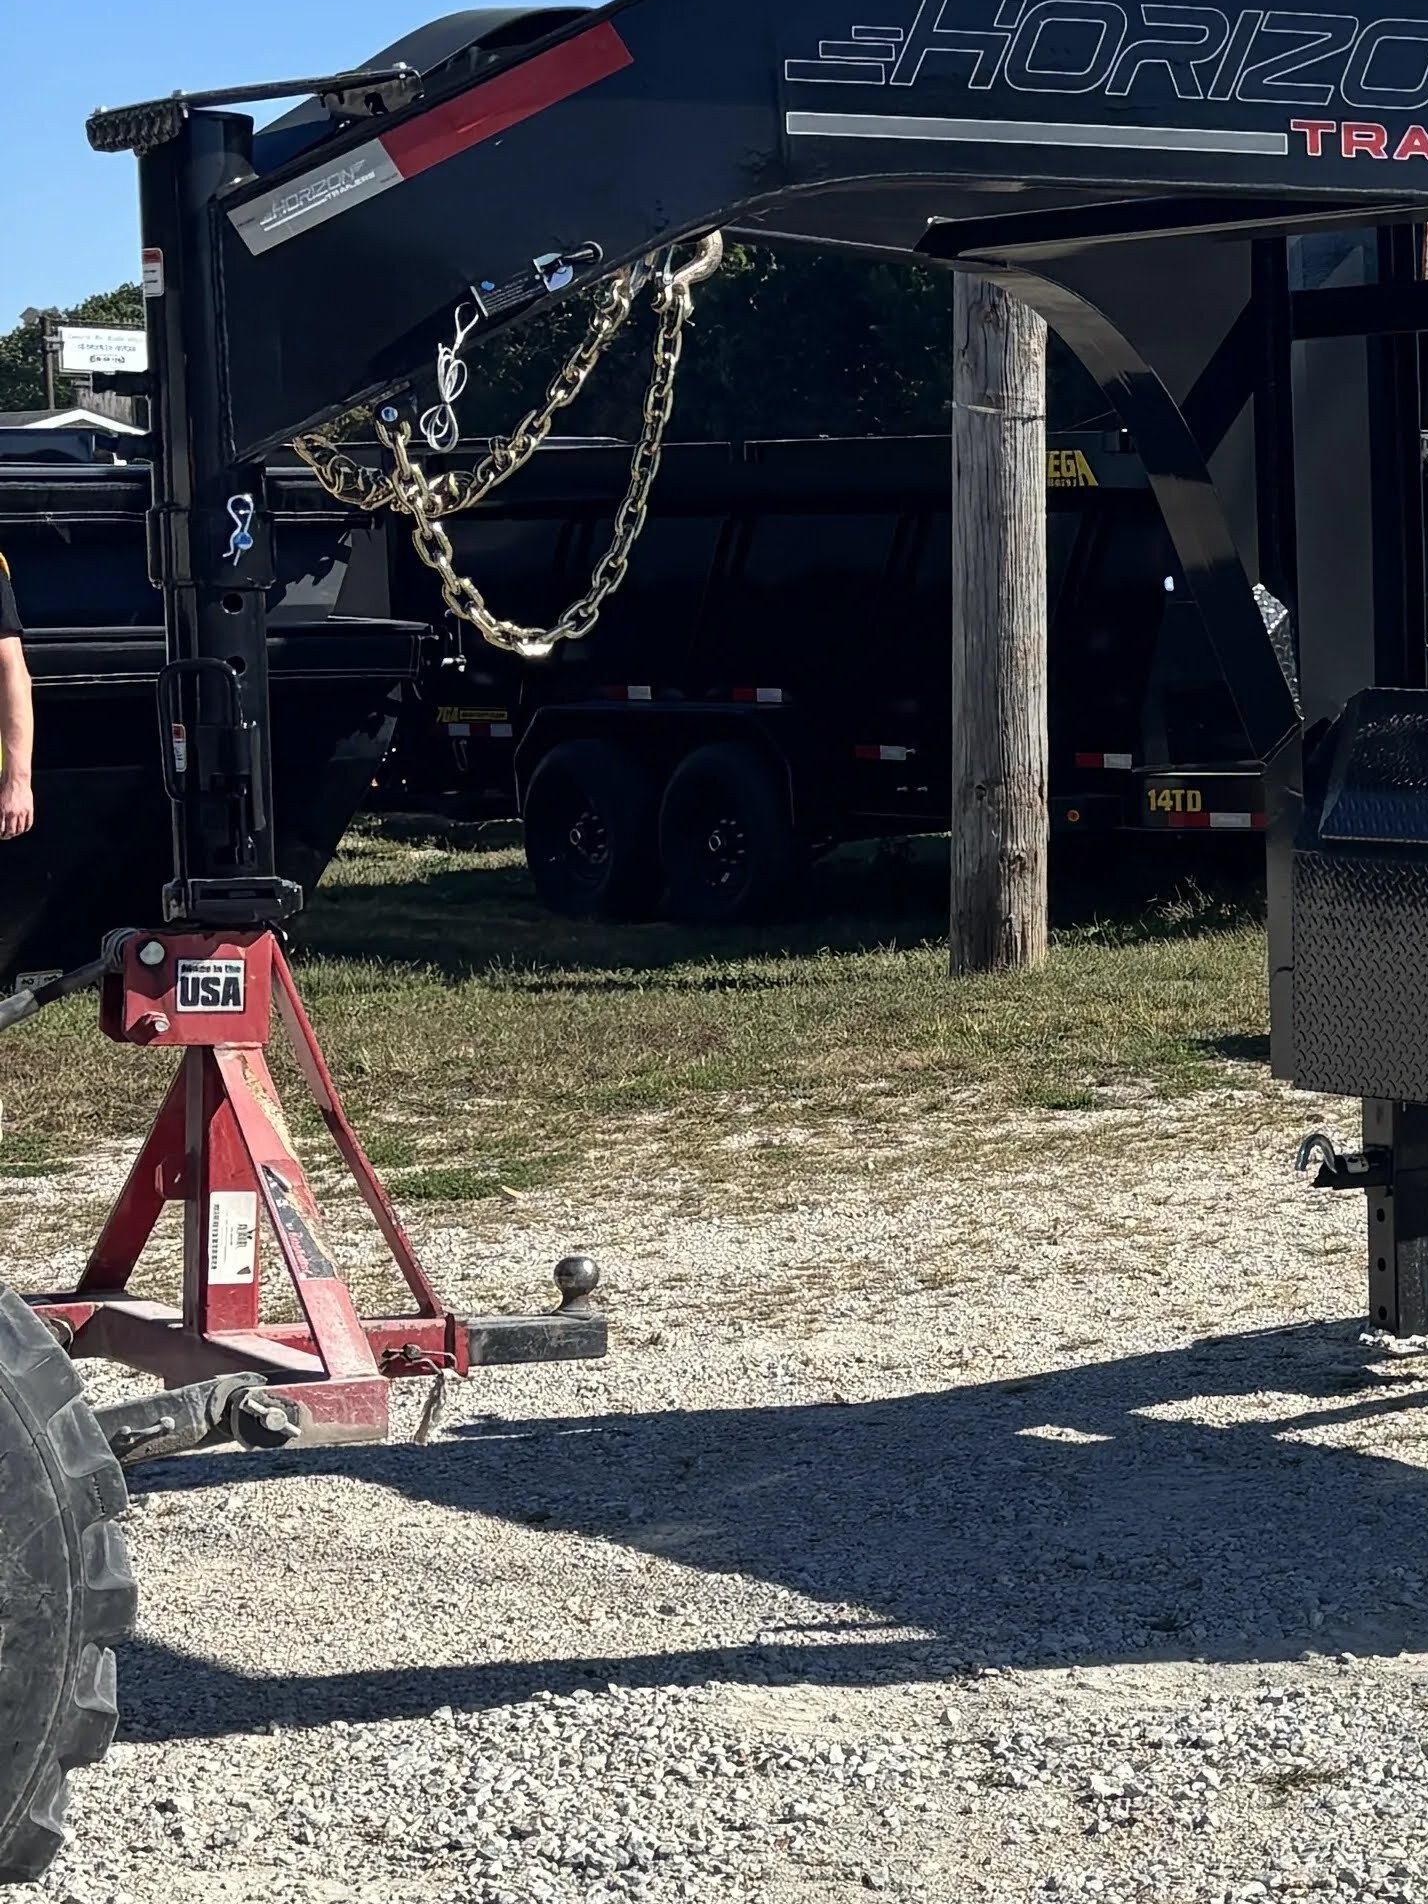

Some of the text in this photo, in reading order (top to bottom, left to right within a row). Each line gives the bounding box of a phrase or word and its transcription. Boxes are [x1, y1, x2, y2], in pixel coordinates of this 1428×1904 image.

[268, 164, 360, 218] HORIZON
[1046, 450, 1099, 486] EGA
[1148, 789, 1202, 812] 14TD
[180, 977, 241, 1006] USA
